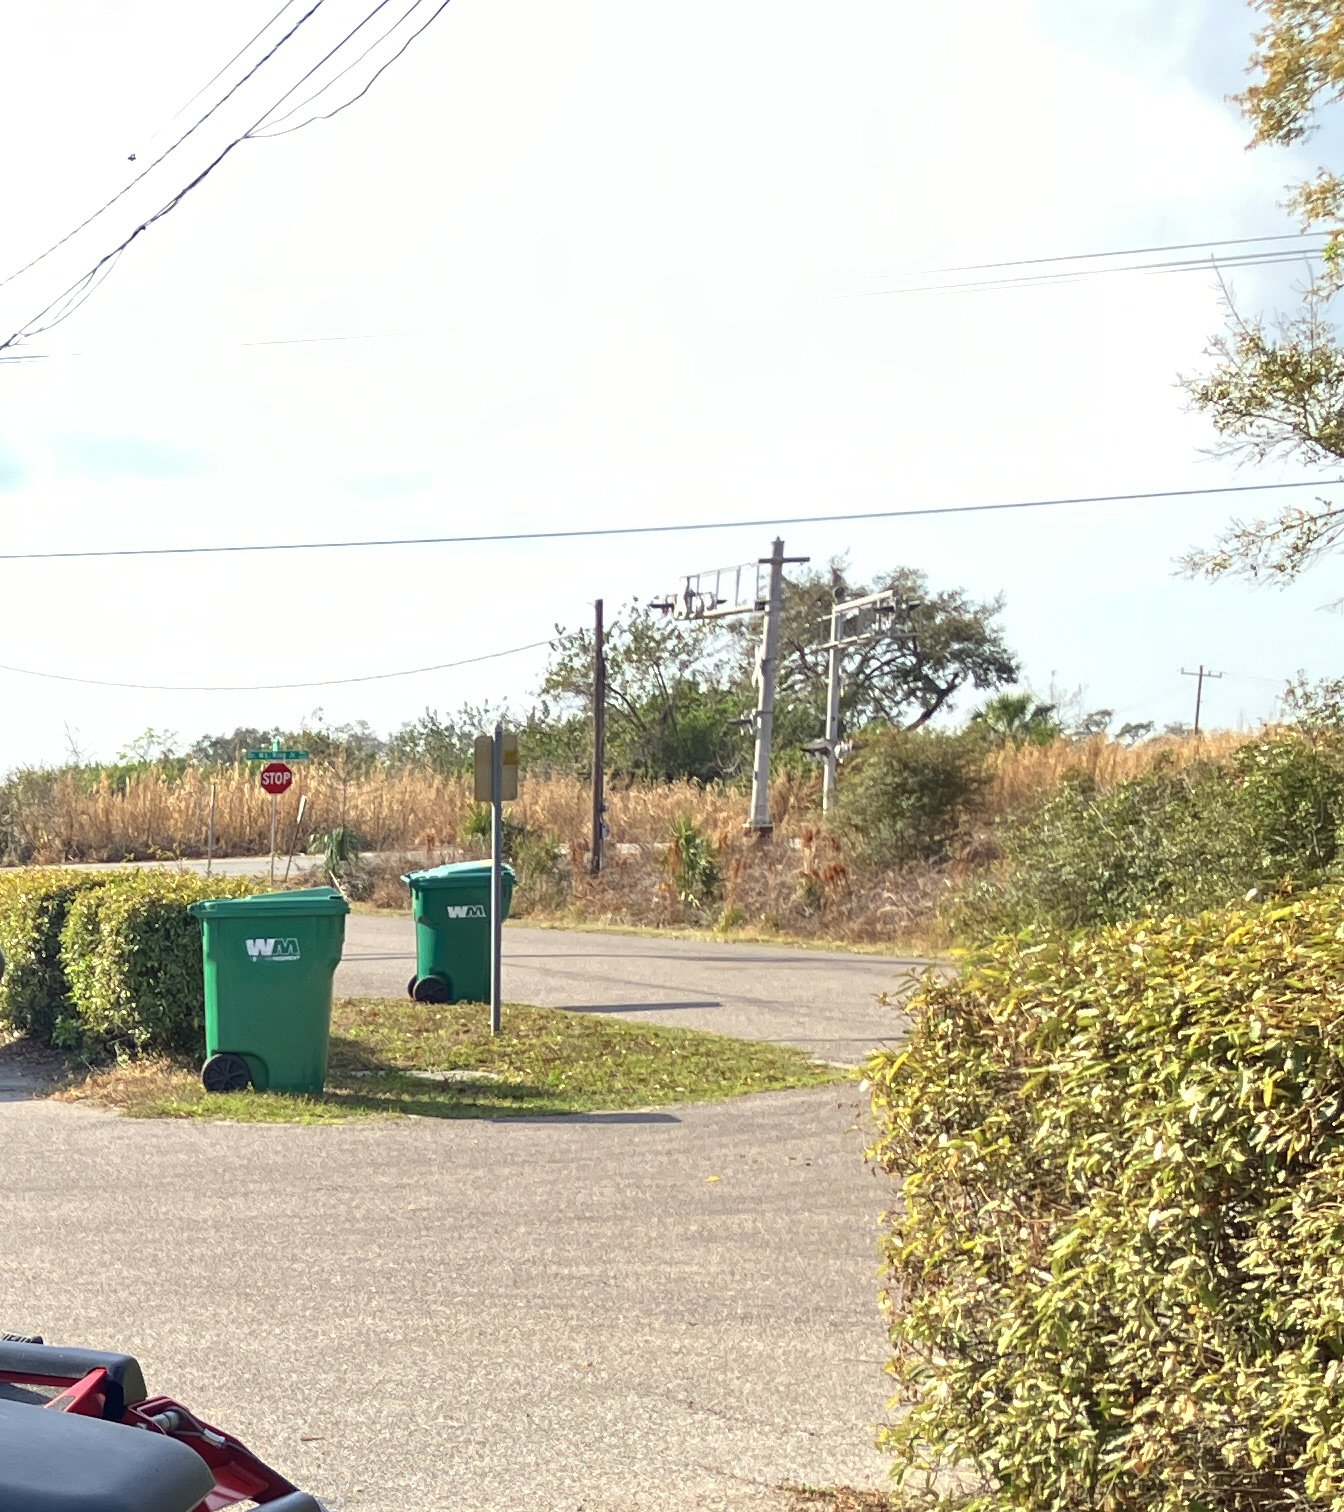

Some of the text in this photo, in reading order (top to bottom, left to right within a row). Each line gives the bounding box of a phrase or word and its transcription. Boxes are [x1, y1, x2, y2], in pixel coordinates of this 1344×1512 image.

[262, 772, 291, 785] STOP
[447, 904, 486, 918] WM
[245, 938, 300, 956] WM
